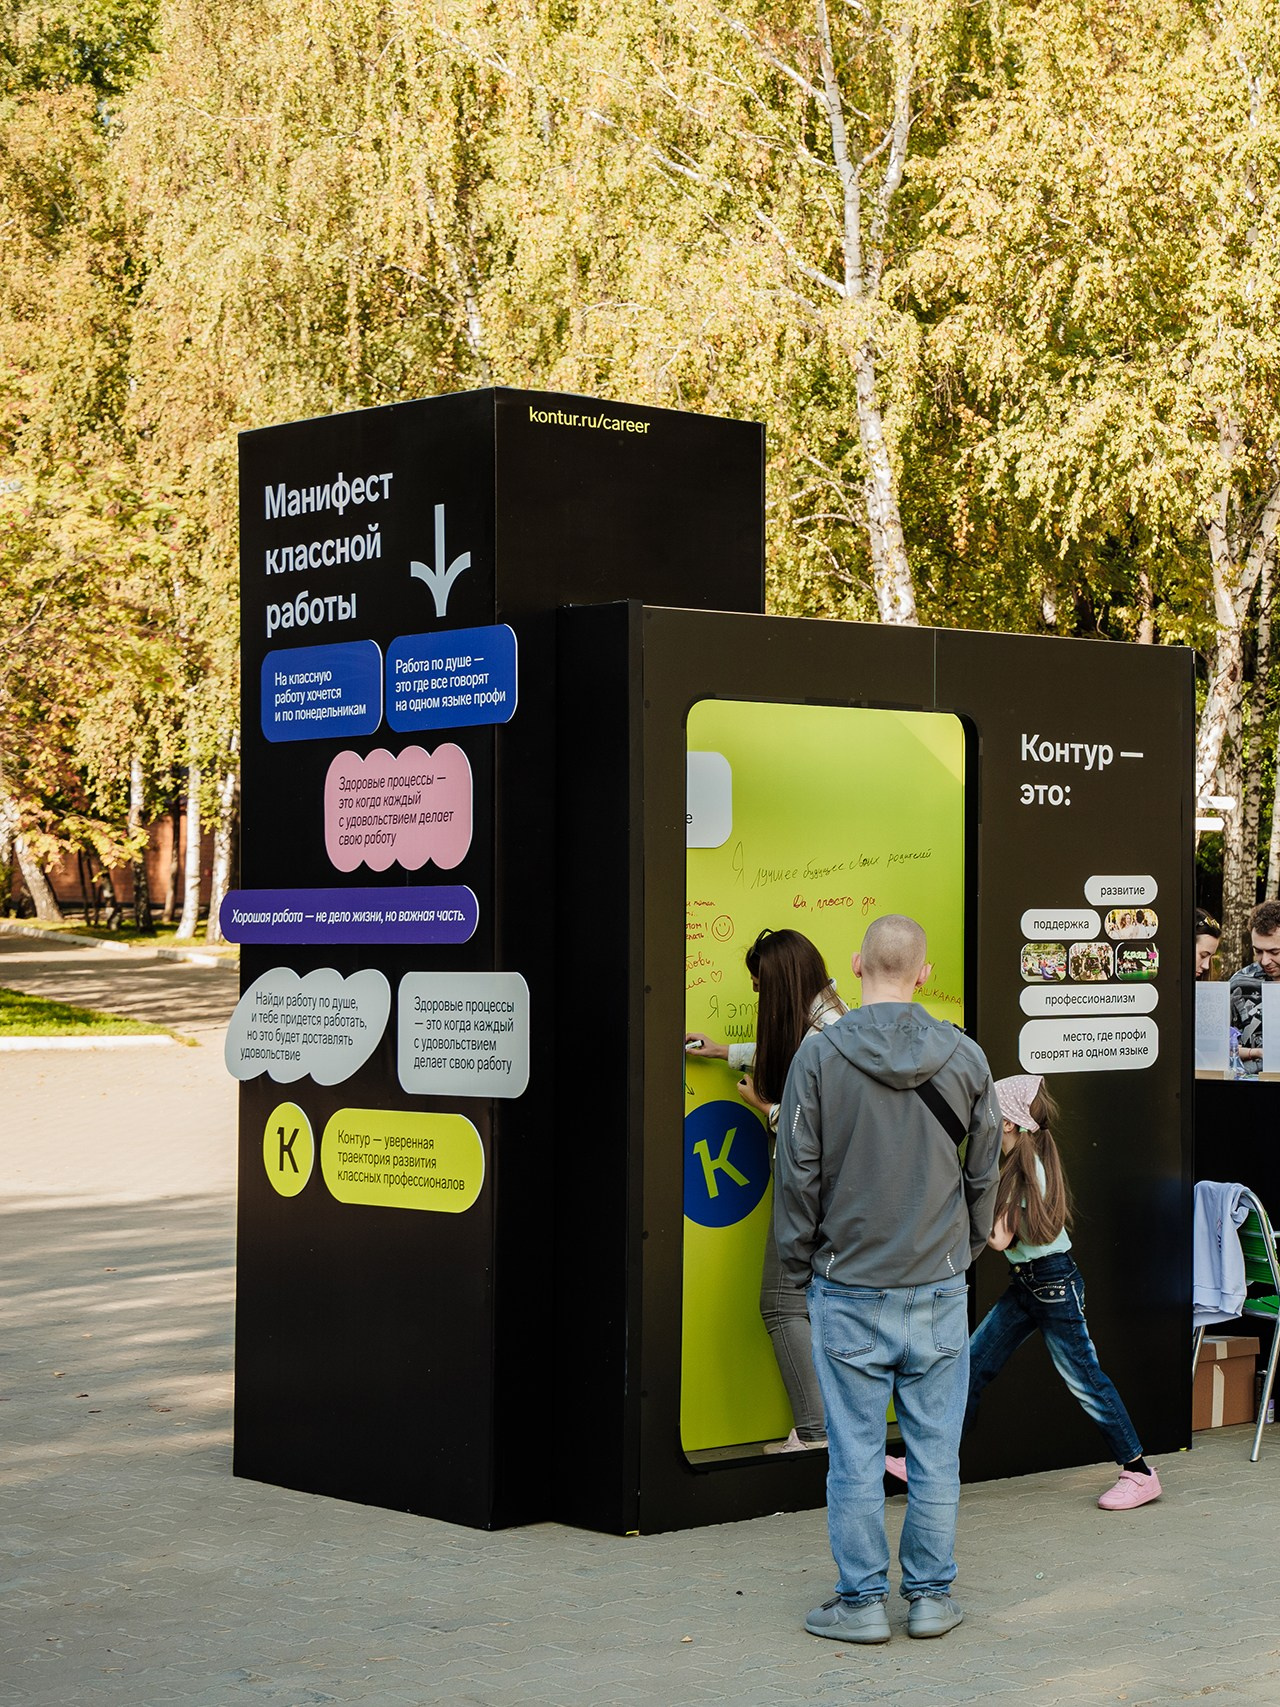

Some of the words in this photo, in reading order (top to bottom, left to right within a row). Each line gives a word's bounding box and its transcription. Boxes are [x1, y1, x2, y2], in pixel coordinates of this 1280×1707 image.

[529, 406, 650, 433] kontur.ru/career
[265, 472, 393, 520] Манифест
[266, 523, 381, 575] классной
[266, 590, 356, 638] работы
[395, 658, 429, 674] Работа
[431, 659, 444, 672] по
[445, 656, 471, 670] душе
[274, 672, 287, 686] На
[289, 669, 332, 686] классную
[395, 680, 411, 693] это
[413, 679, 429, 692] где
[431, 677, 448, 690] все
[450, 672, 489, 690] говорят
[274, 689, 305, 707] работу
[307, 687, 342, 700] хочется
[395, 699, 408, 712] на
[410, 697, 440, 712] одном
[442, 693, 472, 707] языке
[474, 687, 506, 707] профи
[274, 712, 281, 722] и
[282, 710, 294, 722] по
[295, 703, 366, 721] понедельникам
[1021, 733, 1113, 771] Контур
[338, 776, 385, 792] Здоровые
[387, 773, 435, 790] процессы
[338, 797, 354, 809] это
[355, 794, 381, 809] когда
[383, 790, 422, 807] каждый
[1020, 783, 1071, 806] это:
[338, 816, 345, 828] с
[346, 812, 417, 830] удовольствием
[418, 810, 454, 826] делает
[338, 834, 363, 846] свою
[364, 830, 397, 847] работу
[1100, 885, 1145, 898] развитие
[231, 909, 270, 926] Хорошая
[272, 908, 304, 925] работа
[316, 911, 327, 923] не
[328, 911, 351, 924] дело
[352, 910, 384, 925] жизни,
[385, 910, 397, 922] но
[399, 909, 435, 922] важная
[436, 909, 466, 922] часть.
[1033, 918, 1090, 932] поддержка
[255, 991, 284, 1009] Найди
[286, 992, 318, 1011] работу
[319, 996, 331, 1009] по
[332, 997, 359, 1011] душе,
[414, 996, 463, 1015] Здоровые
[465, 1000, 515, 1016] процессы
[707, 995, 719, 1019] Я
[1045, 993, 1136, 1007] профессионализм
[251, 1012, 257, 1023] и
[259, 1009, 278, 1024] тебе
[280, 1013, 322, 1028] придется
[323, 1013, 367, 1030] работать,
[426, 1018, 442, 1031] это
[444, 1019, 471, 1033] когда
[473, 1017, 514, 1033] каждый
[247, 1030, 258, 1041] но
[260, 1030, 274, 1042] это
[275, 1028, 300, 1044] будет
[302, 1033, 354, 1048] доставлять
[414, 1037, 420, 1049] с
[421, 1037, 497, 1053] удовольствием
[1062, 1031, 1096, 1043] место,
[1097, 1030, 1114, 1042] где
[1115, 1028, 1147, 1042] профи
[240, 1046, 301, 1062] удовольствие
[1030, 1048, 1070, 1061] говорят
[1072, 1048, 1084, 1058] на
[1086, 1047, 1118, 1059] одном
[1119, 1045, 1149, 1057] языке
[413, 1056, 447, 1071] делает
[449, 1057, 475, 1070] свою
[477, 1056, 513, 1075] работу
[338, 1129, 371, 1148] Контур
[384, 1136, 435, 1151] уверенная
[338, 1150, 391, 1168] траектория
[392, 1155, 437, 1171] развития
[338, 1170, 381, 1186] классных
[383, 1171, 465, 1191] профессионалов
